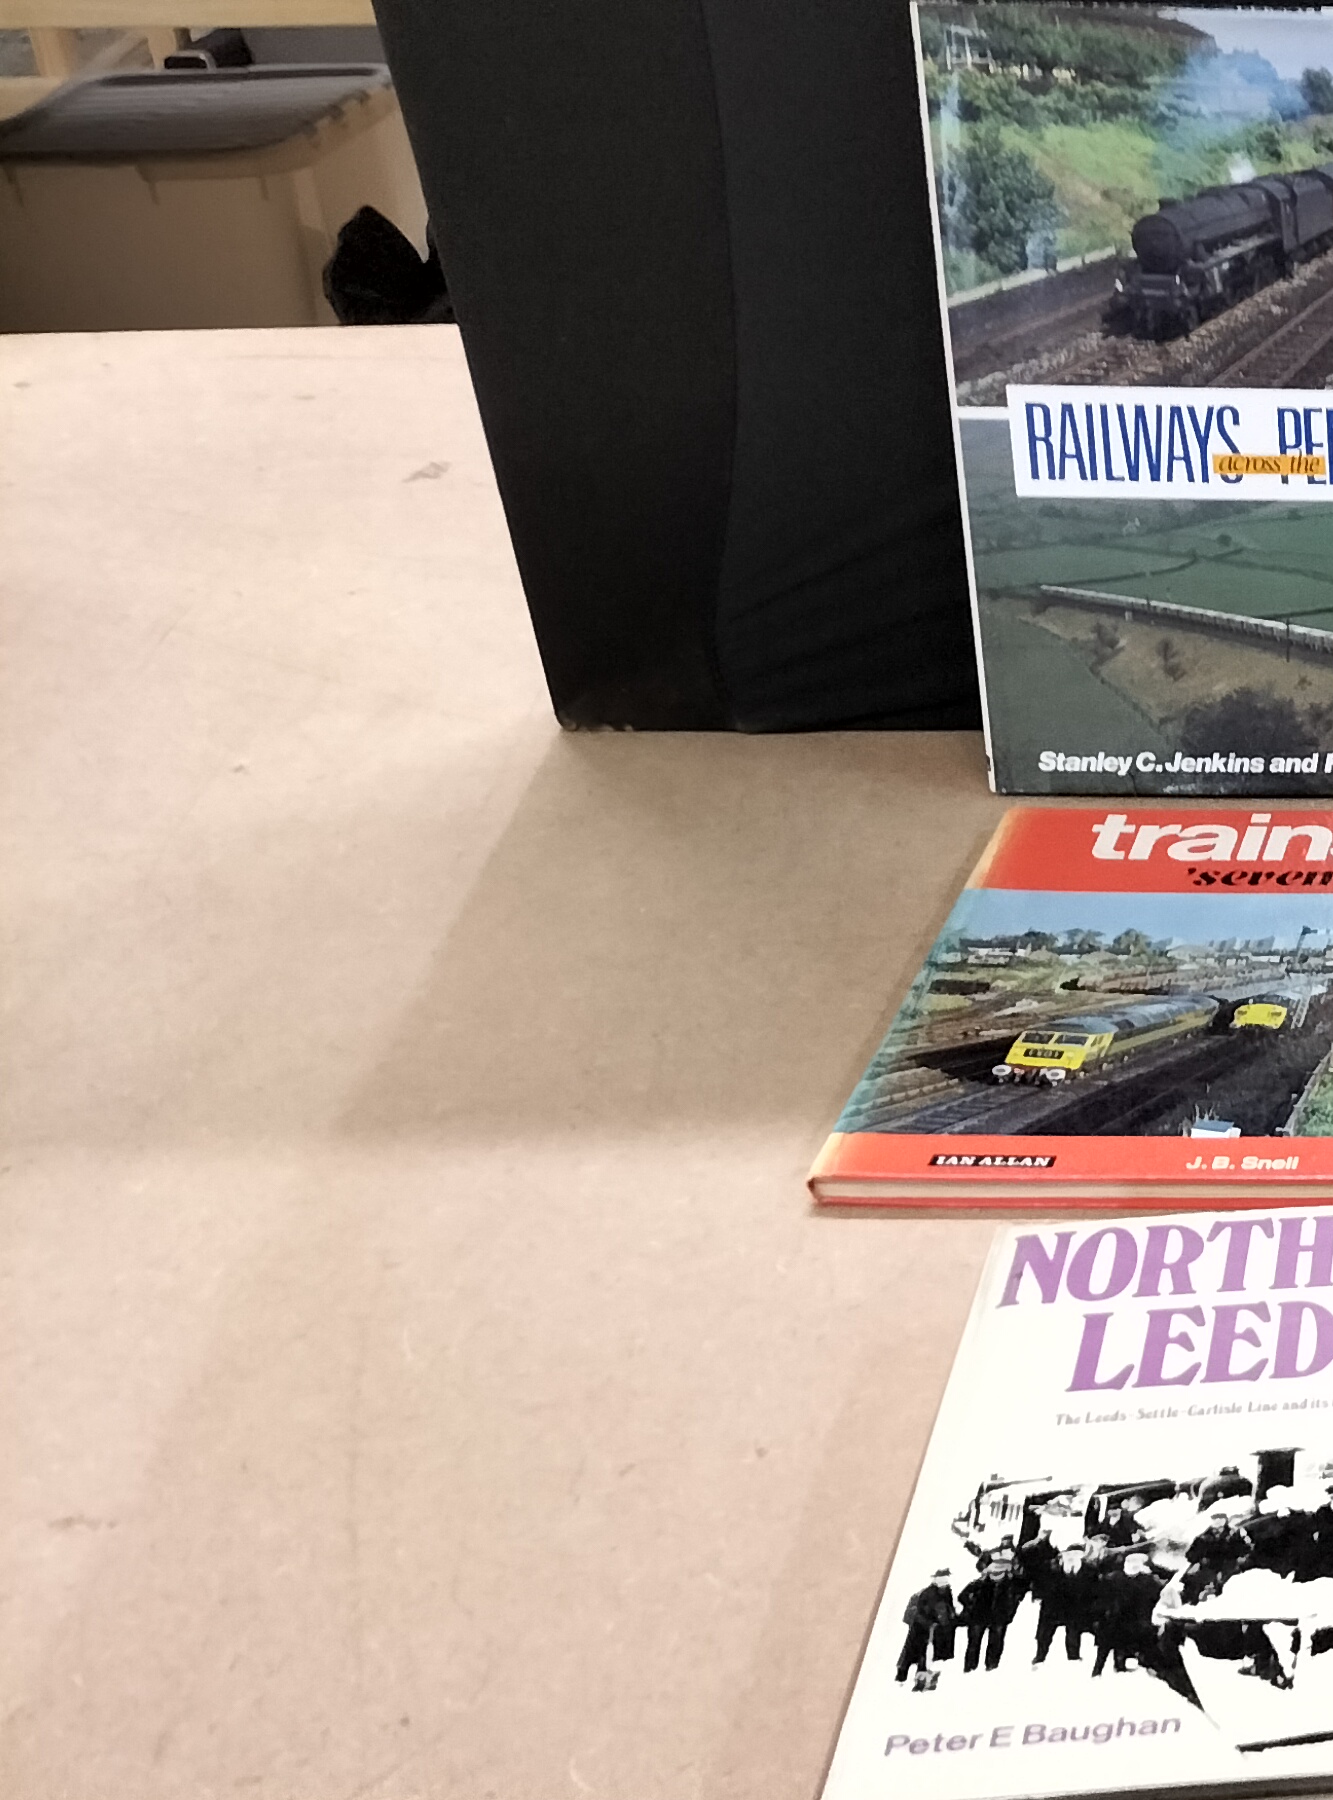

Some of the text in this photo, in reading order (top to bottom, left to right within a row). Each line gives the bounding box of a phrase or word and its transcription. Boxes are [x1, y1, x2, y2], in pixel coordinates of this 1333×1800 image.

[1025, 402, 1243, 484] RAILWAYS
[1218, 454, 1320, 474] across the
[1038, 751, 1132, 775] Stanley
[1269, 753, 1317, 774] and
[935, 1156, 1054, 1167] IAN ALLAN
[1240, 1156, 1299, 1169] Snell
[1055, 1414, 1080, 1426] The
[1248, 1401, 1278, 1413] Line
[1282, 1398, 1308, 1411] and
[1311, 1397, 1329, 1409] its
[883, 1716, 1181, 1757] Peter E Baughan
